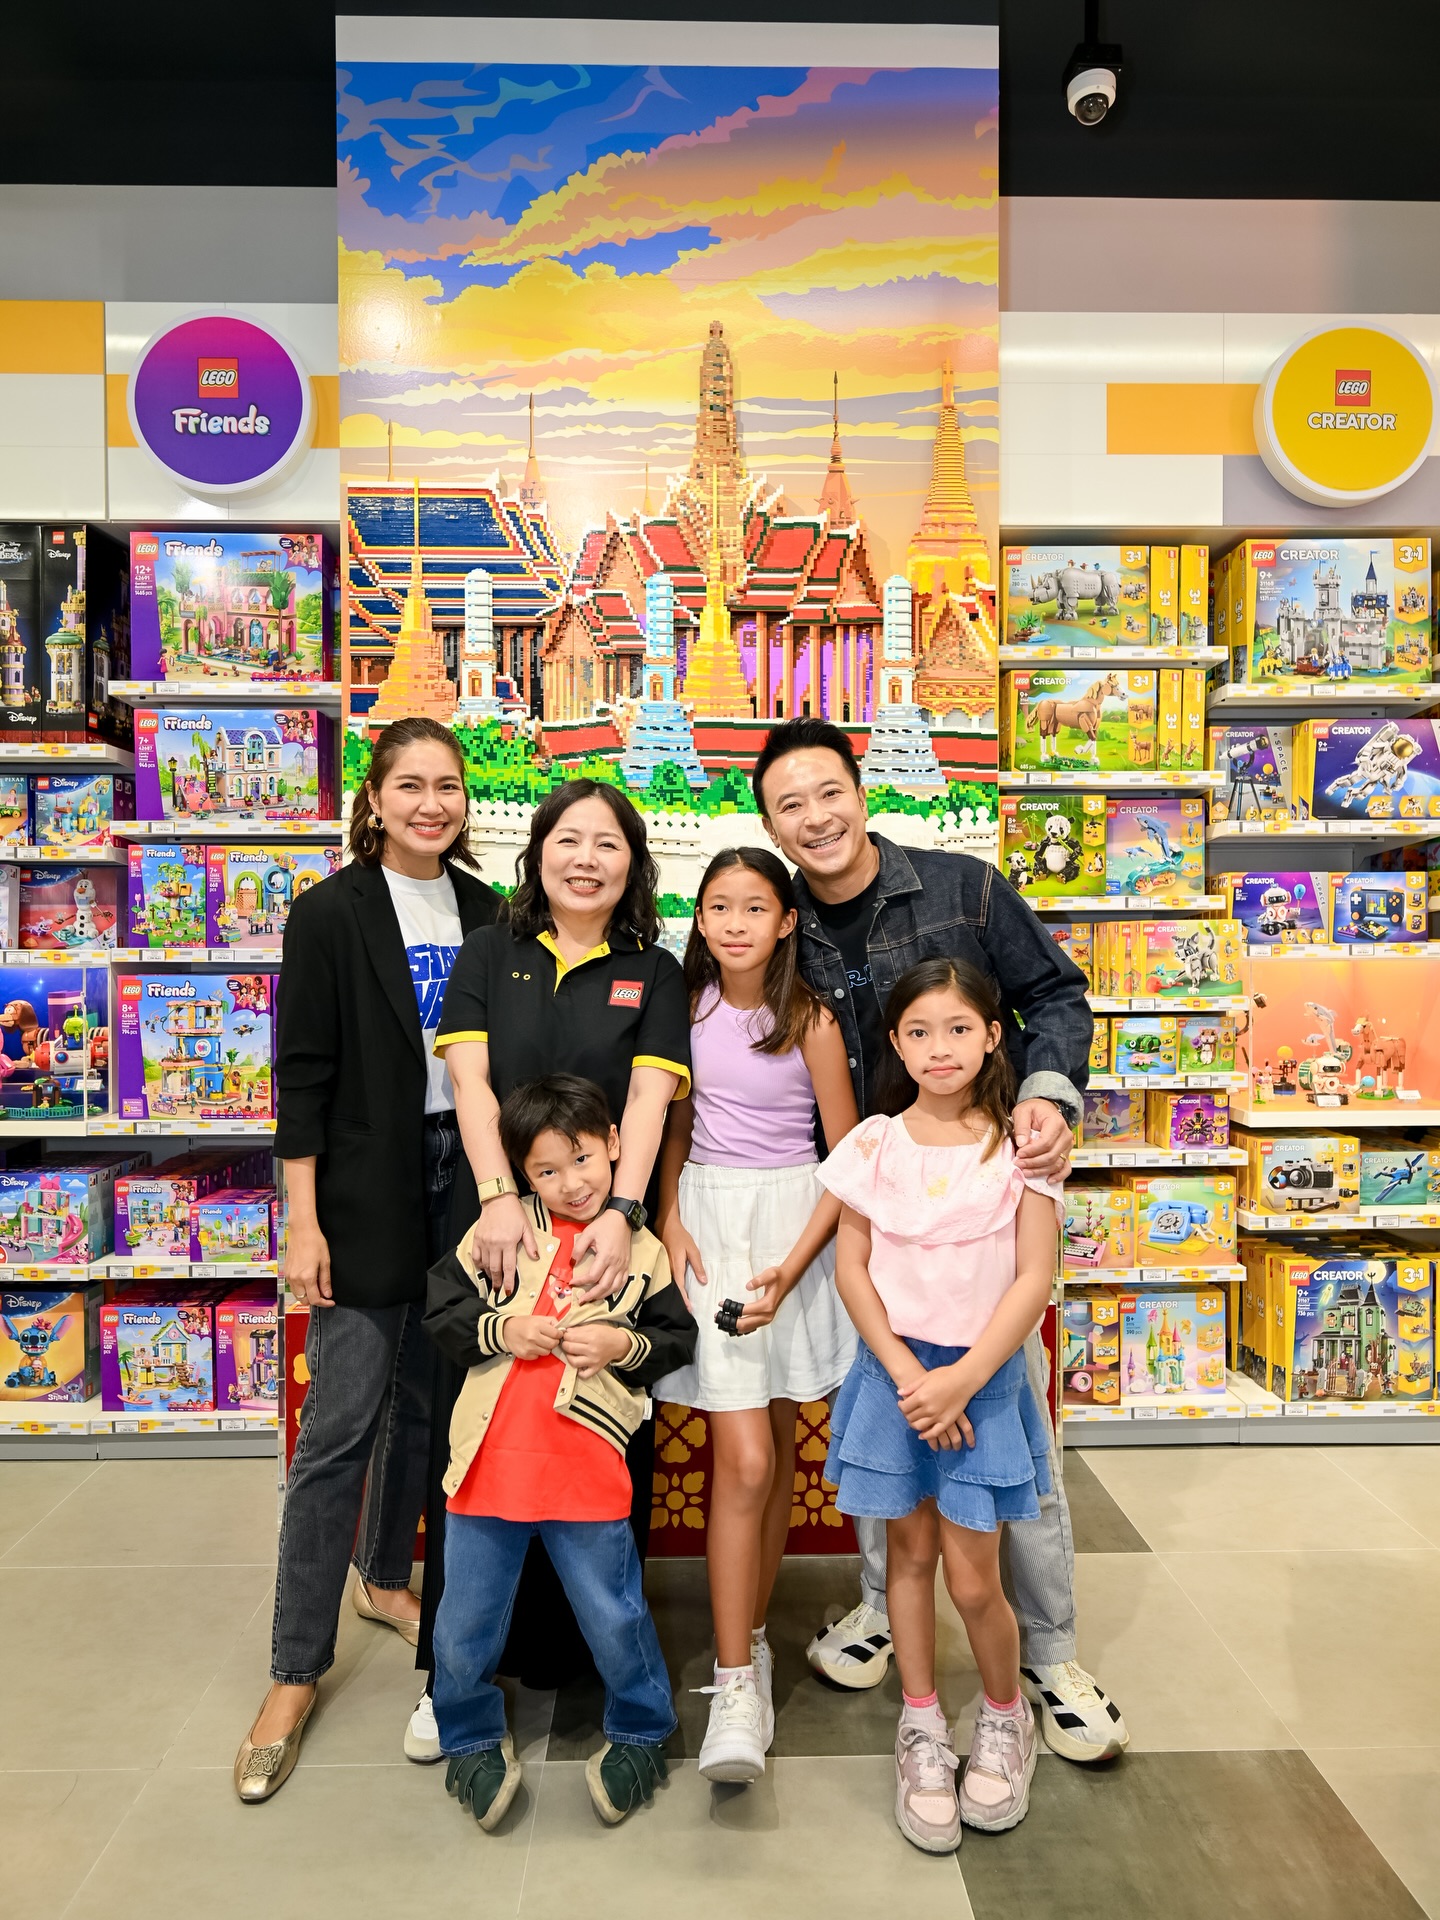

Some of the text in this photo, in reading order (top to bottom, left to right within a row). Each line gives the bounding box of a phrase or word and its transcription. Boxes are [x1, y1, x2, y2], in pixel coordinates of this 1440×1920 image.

[201, 369, 237, 387] LEGO
[1337, 380, 1370, 396] LEGO
[171, 403, 271, 436] Friends
[1306, 411, 1397, 431] CREATOR
[136, 538, 223, 557] LEGO Friends
[47, 549, 71, 560] Disney
[1007, 553, 1022, 561] LEGO
[1025, 553, 1065, 561] CREATOR
[1253, 550, 1275, 561] LEGO
[1280, 549, 1339, 561] CREATOR
[134, 565, 151, 574] 12+
[1259, 571, 1273, 580] 9+
[1032, 677, 1072, 685] CREATOR
[7, 711, 37, 725] Disney
[138, 713, 213, 731] LEGO Friends
[1331, 726, 1372, 735] CREATOR
[138, 737, 149, 745] 7+
[1274, 739, 1288, 772] SPACE
[51, 776, 79, 789] Disney
[1019, 803, 1060, 811] CREATOR
[1119, 806, 1158, 814] CREATOR
[146, 848, 176, 858] Friends
[229, 849, 269, 863] Friends
[33, 869, 60, 881] Disney
[1245, 877, 1275, 885] CREATOR
[1344, 877, 1375, 885] CREATOR
[1157, 925, 1187, 933] CREATOR
[121, 980, 197, 998] LEGO Friends
[612, 987, 641, 1000] LEGO
[122, 1004, 133, 1012] 8+
[1274, 1144, 1305, 1152] CREATOR
[1364, 1156, 1394, 1164] CREATOR
[0, 1175, 29, 1188] Disney
[1149, 1183, 1181, 1191] CREATOR
[132, 1183, 162, 1194] Friends
[1291, 1270, 1309, 1281] LEGO
[1313, 1270, 1364, 1281] CREATOR
[1297, 1289, 1309, 1297] 9+
[4, 1294, 42, 1311] Disney
[1120, 1301, 1136, 1309] LEGO
[1139, 1301, 1179, 1310] CREATOR
[122, 1310, 162, 1325] Friends
[238, 1310, 278, 1325] Friends
